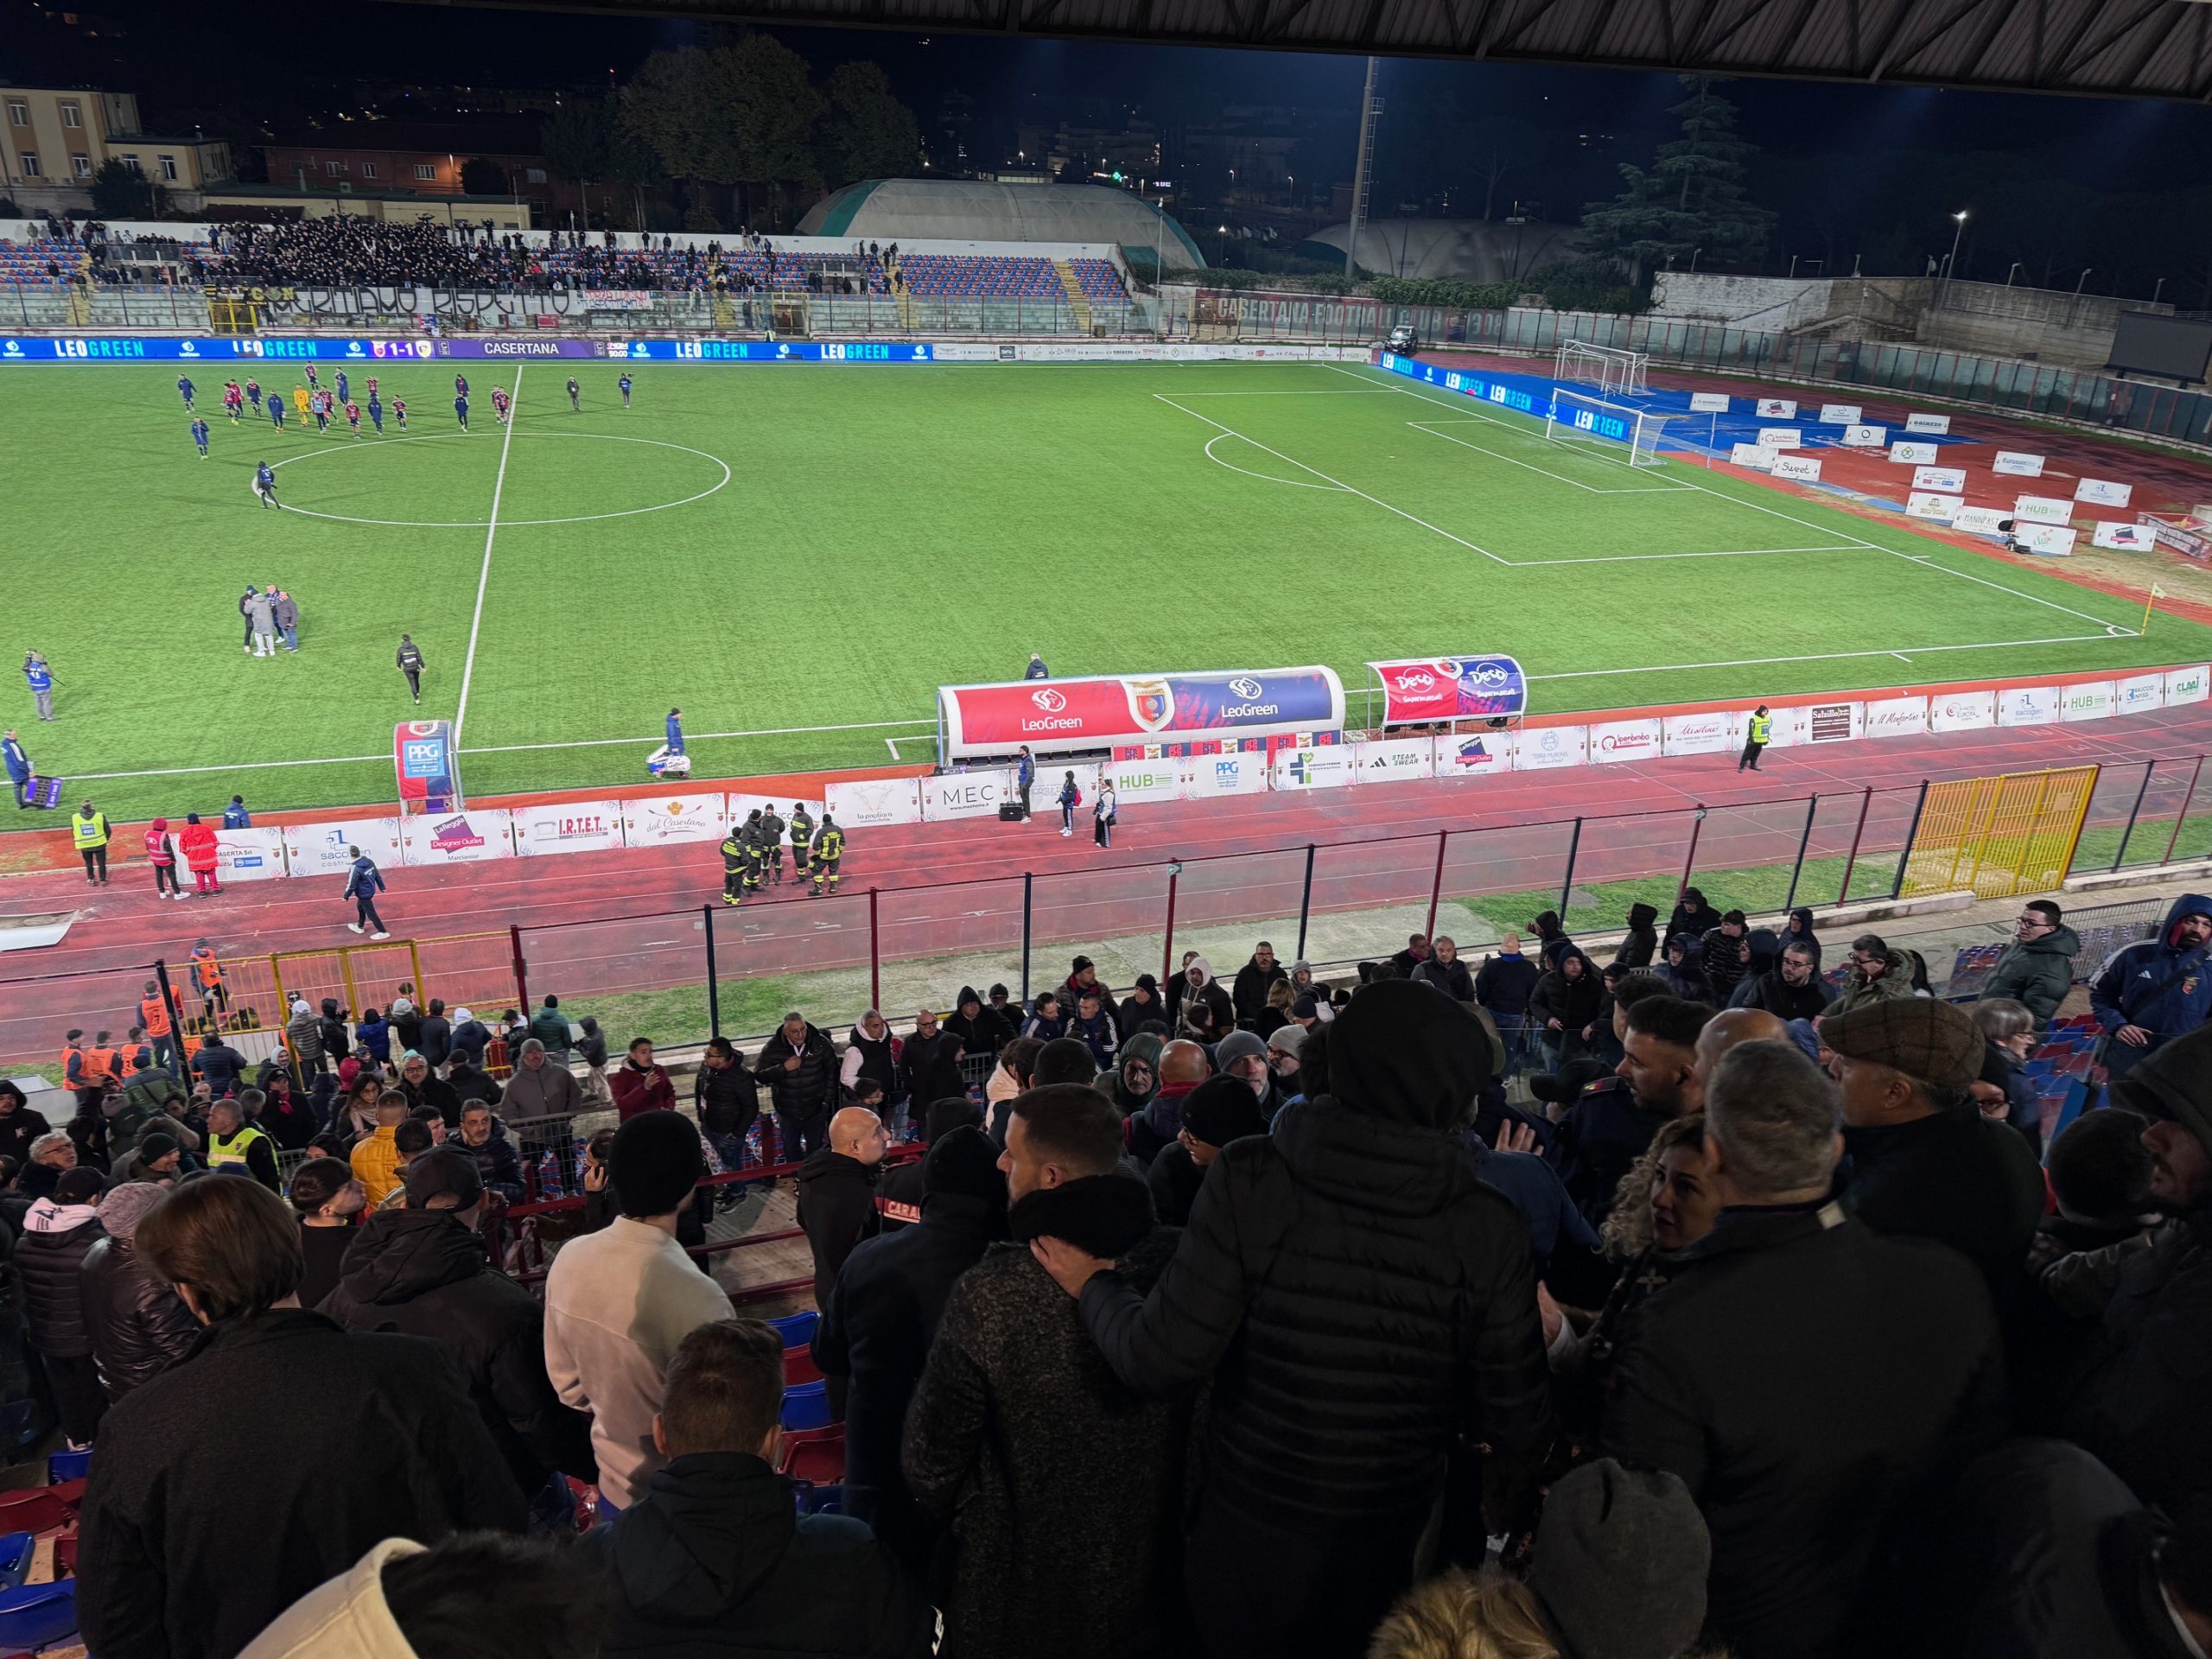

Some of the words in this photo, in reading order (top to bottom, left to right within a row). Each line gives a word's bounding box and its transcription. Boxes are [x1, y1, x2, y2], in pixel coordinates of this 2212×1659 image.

[1218, 298, 1308, 325] CASERTANA
[484, 342, 560, 354] CASERTANA
[1782, 461, 1810, 474] Sweet
[2025, 505, 2049, 514] HUB
[2070, 696, 2094, 709] HUB
[1221, 703, 1278, 718] LeoGreen
[1022, 716, 1082, 732] LeoGreen
[408, 743, 439, 760] PPG
[1216, 761, 1239, 776] PPG
[1119, 774, 1154, 789] HUB
[944, 785, 995, 805] MEC
[646, 819, 661, 832] dal
[432, 841, 461, 849] Designer
